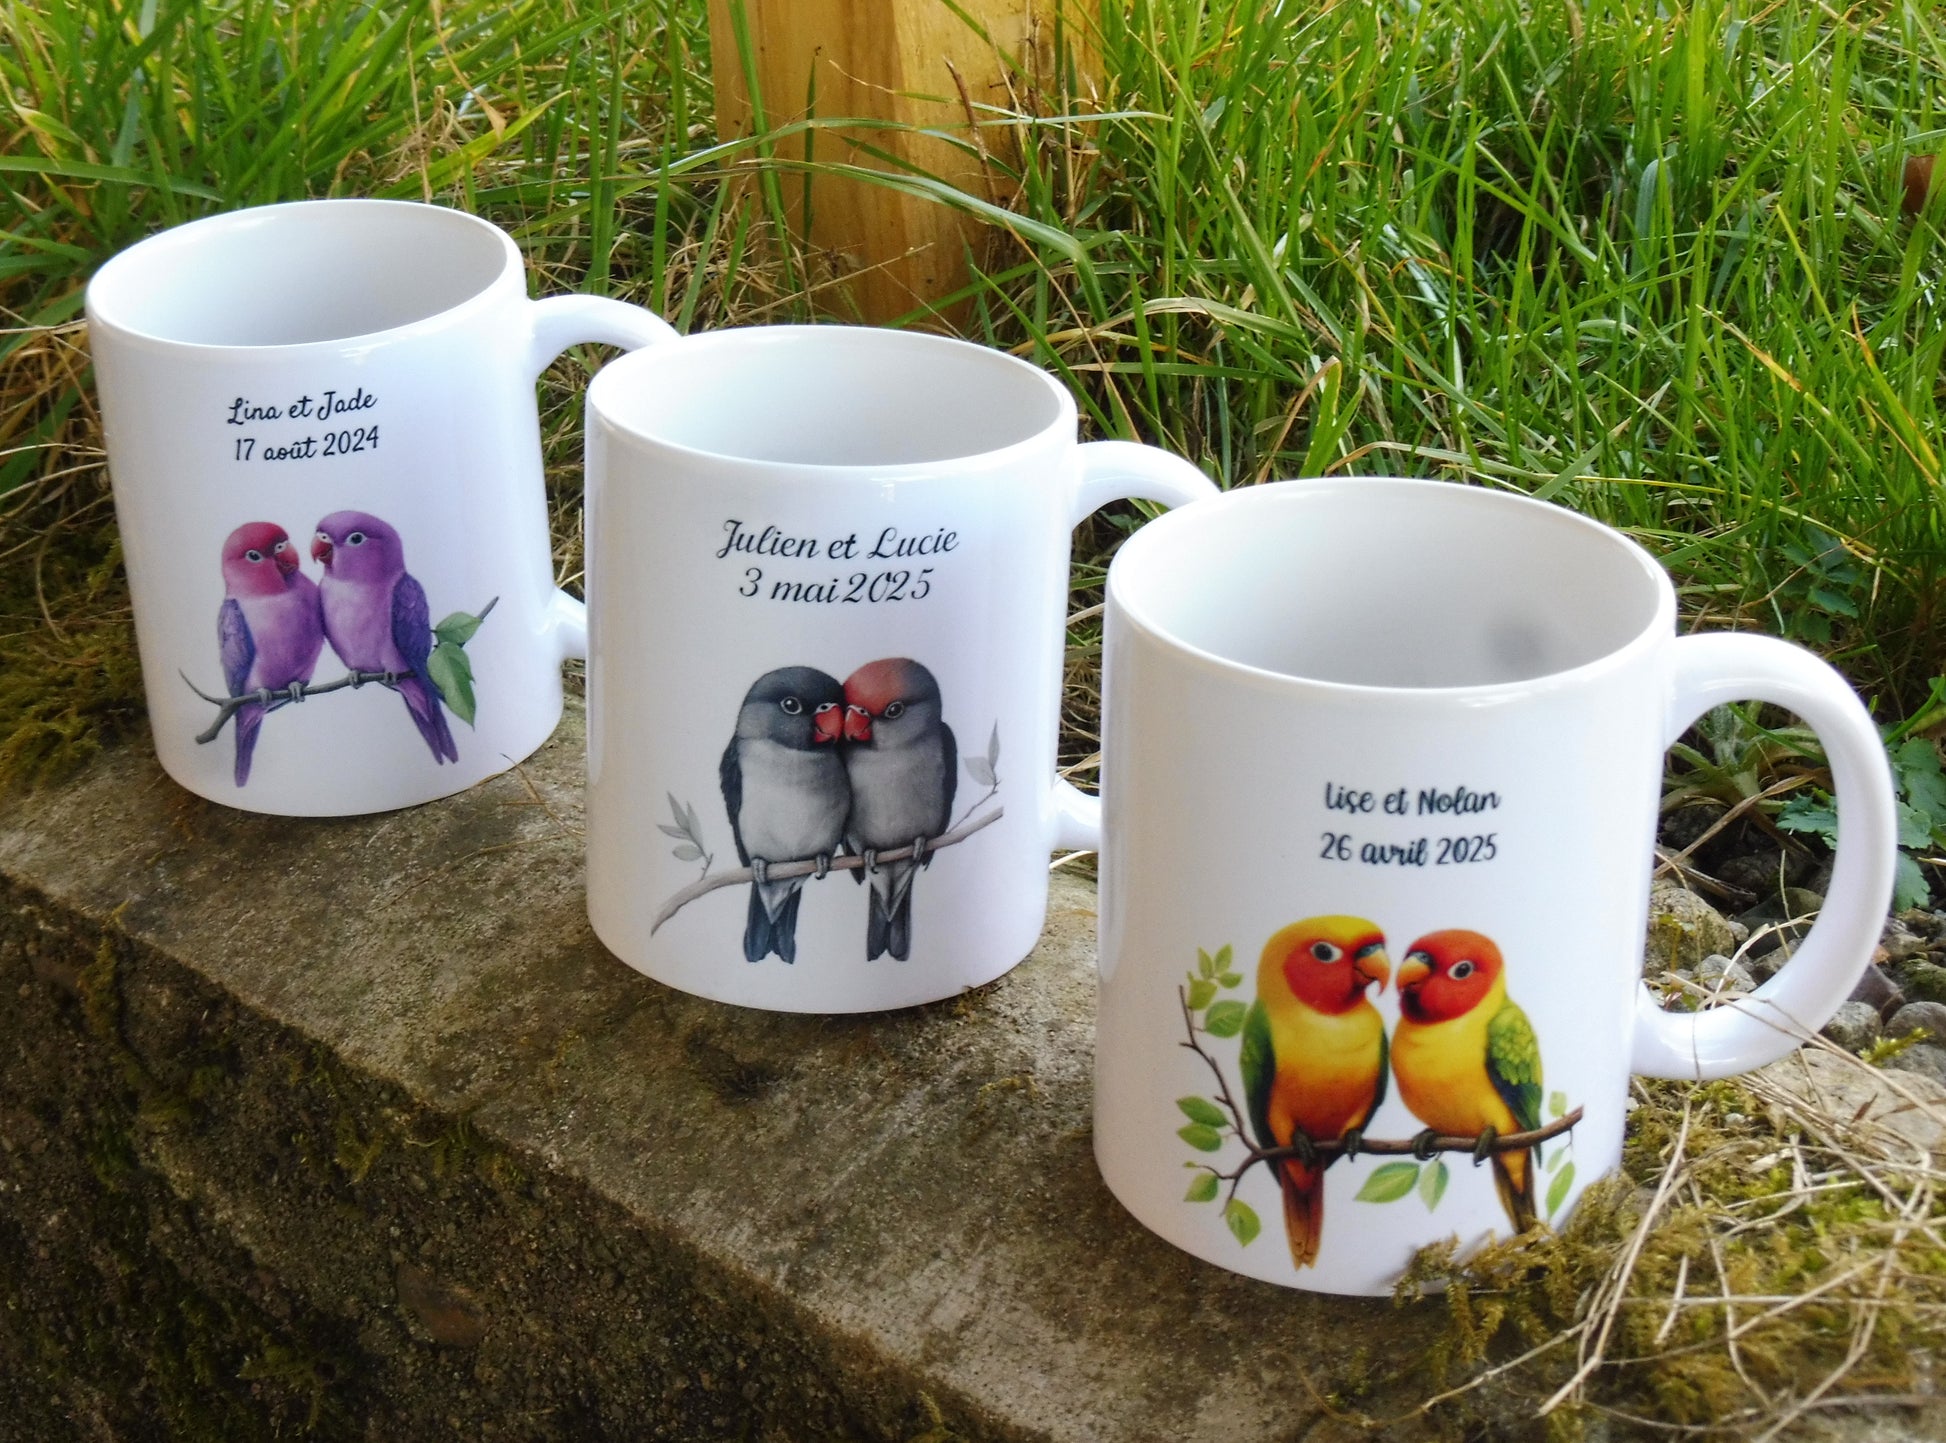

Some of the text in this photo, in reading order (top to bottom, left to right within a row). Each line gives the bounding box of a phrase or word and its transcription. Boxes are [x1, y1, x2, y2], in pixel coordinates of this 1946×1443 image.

[226, 386, 379, 426] Lina et Jade
[234, 424, 380, 462] 17 août 2024
[715, 518, 960, 560] Julien et Lucie
[738, 567, 935, 604] 3 mai 2025
[1382, 787, 1410, 816] et
[1417, 785, 1500, 816] Nolan
[1319, 831, 1498, 868] 26 avril 2025
